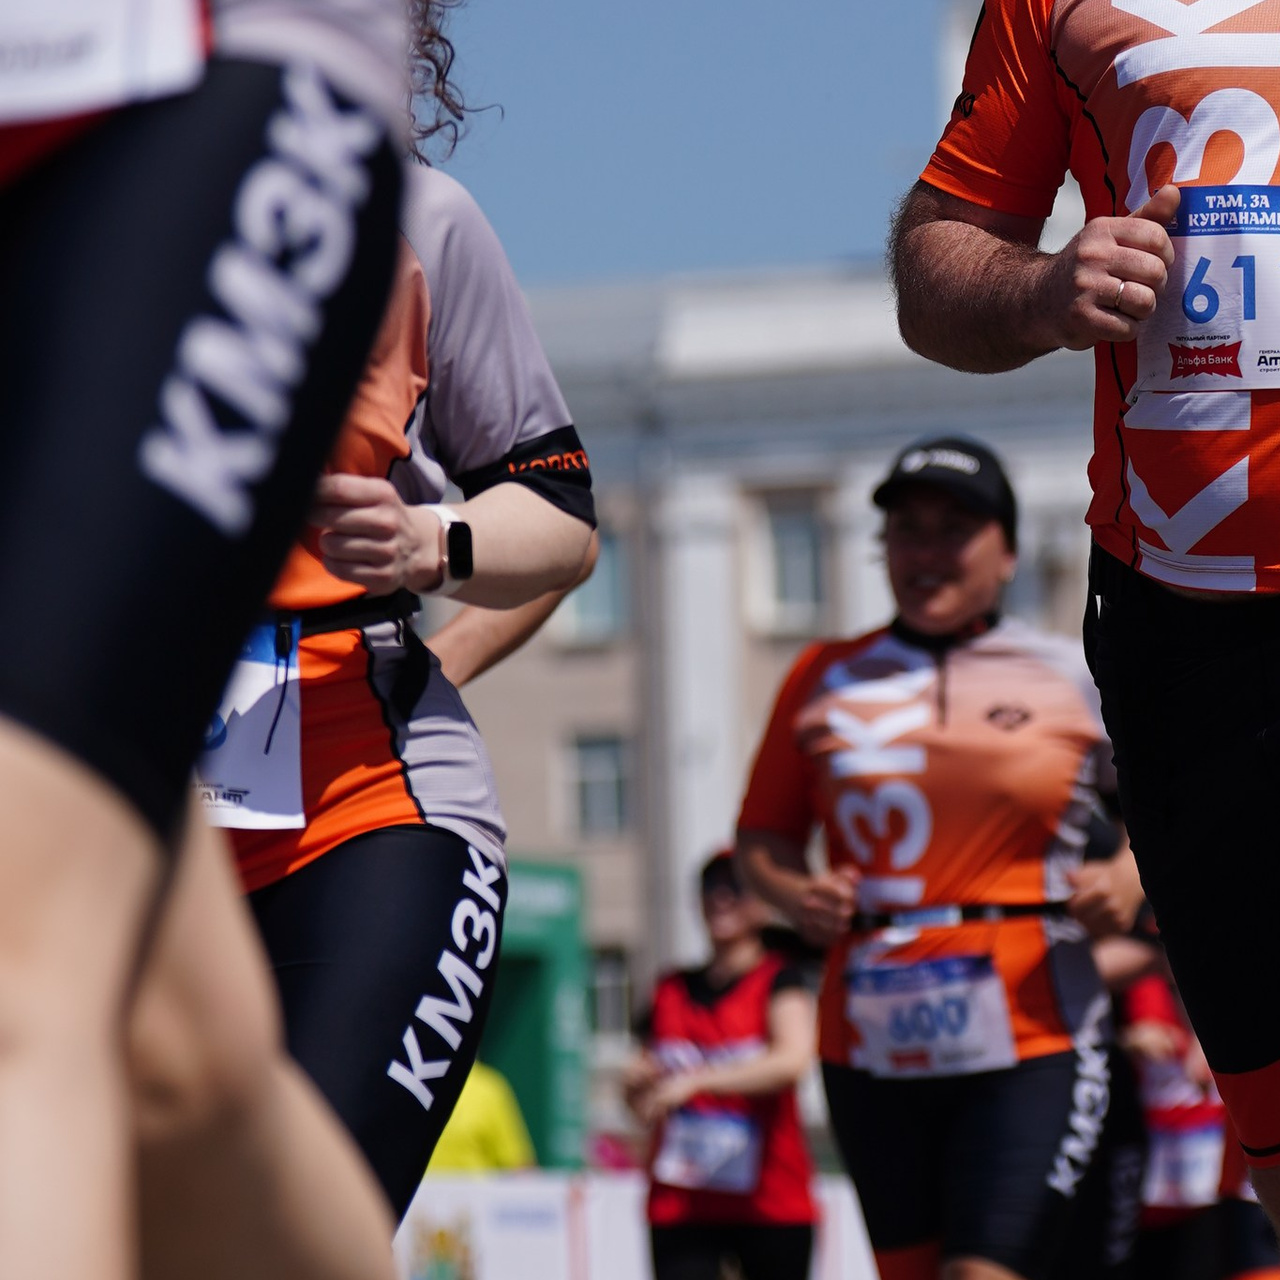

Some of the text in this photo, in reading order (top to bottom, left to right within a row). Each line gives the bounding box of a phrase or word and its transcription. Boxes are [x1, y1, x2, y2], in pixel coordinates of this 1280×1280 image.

[1205, 194, 1270, 210] ТАМ, ЗА
[1177, 354, 1233, 368] Альфа Банк
